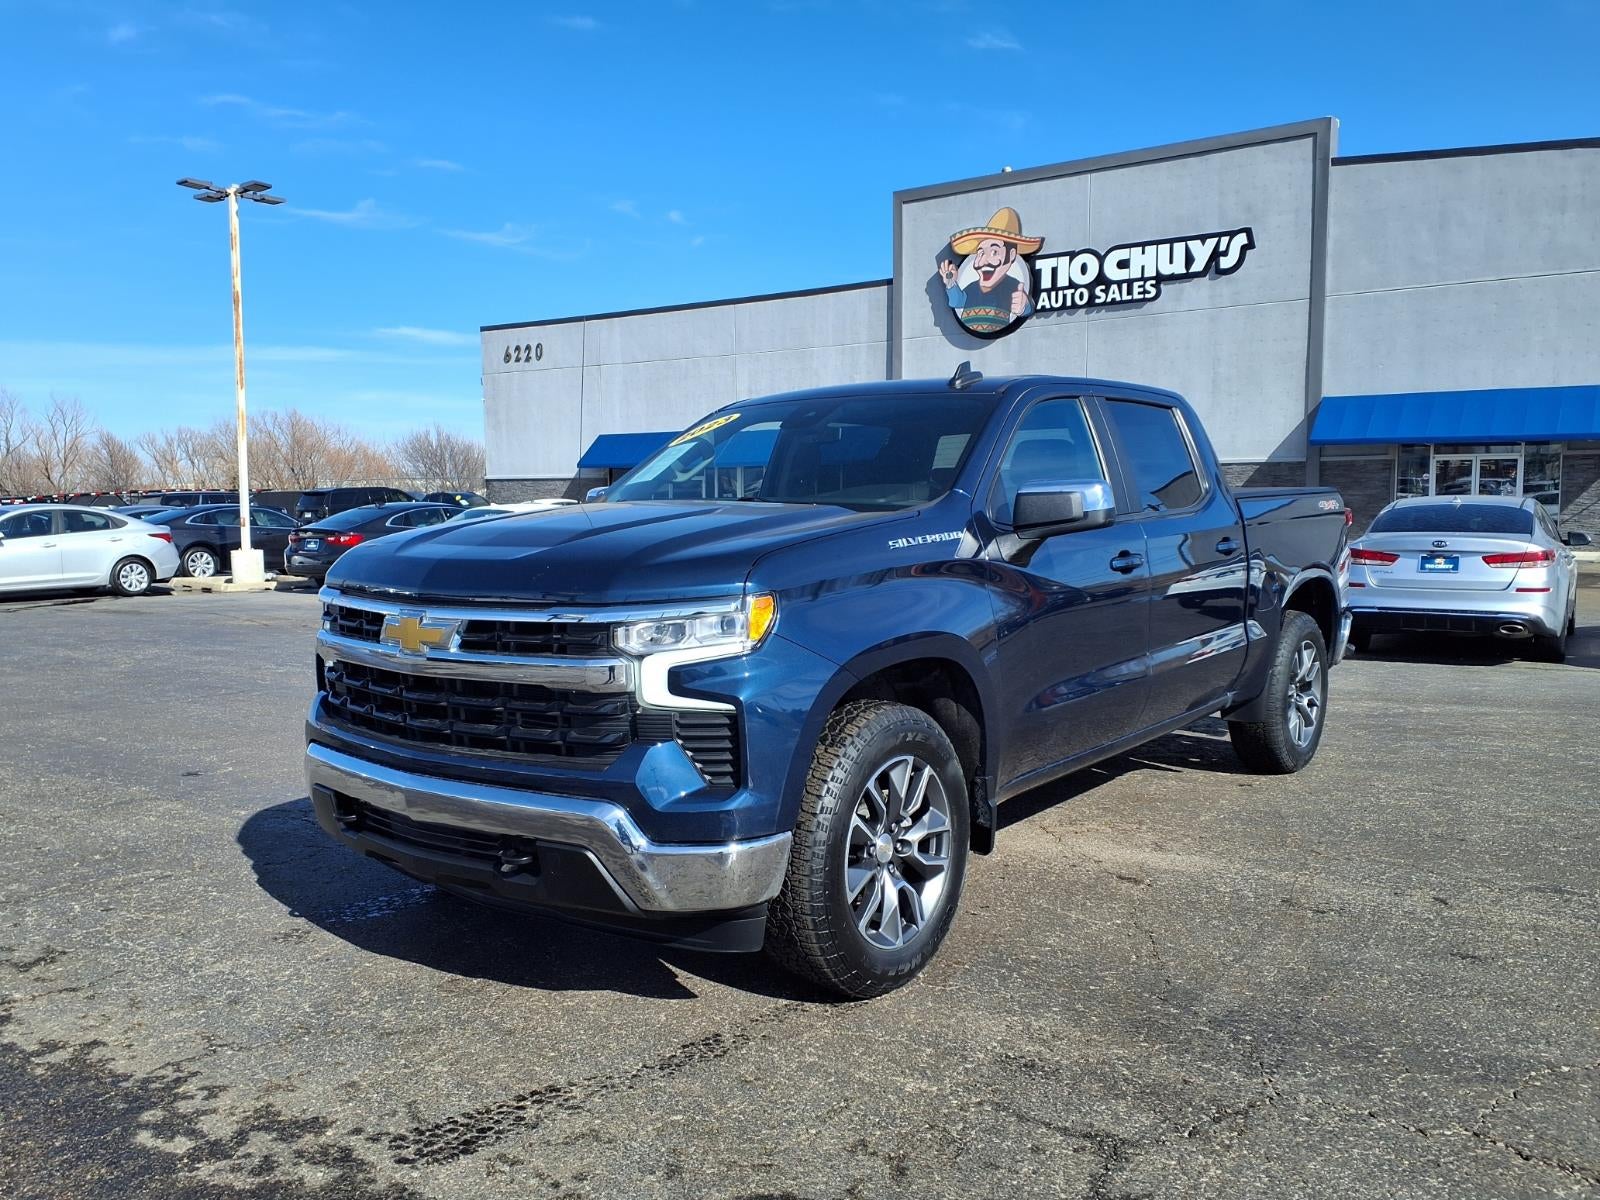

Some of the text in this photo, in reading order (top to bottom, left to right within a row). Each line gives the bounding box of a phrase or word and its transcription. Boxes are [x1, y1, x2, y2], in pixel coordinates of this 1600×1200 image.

[1035, 232, 1249, 290] TIO CHUY'S
[1036, 279, 1157, 310] AUTO SALES
[503, 342, 543, 364] 6220
[888, 531, 964, 549] SILVERADO
